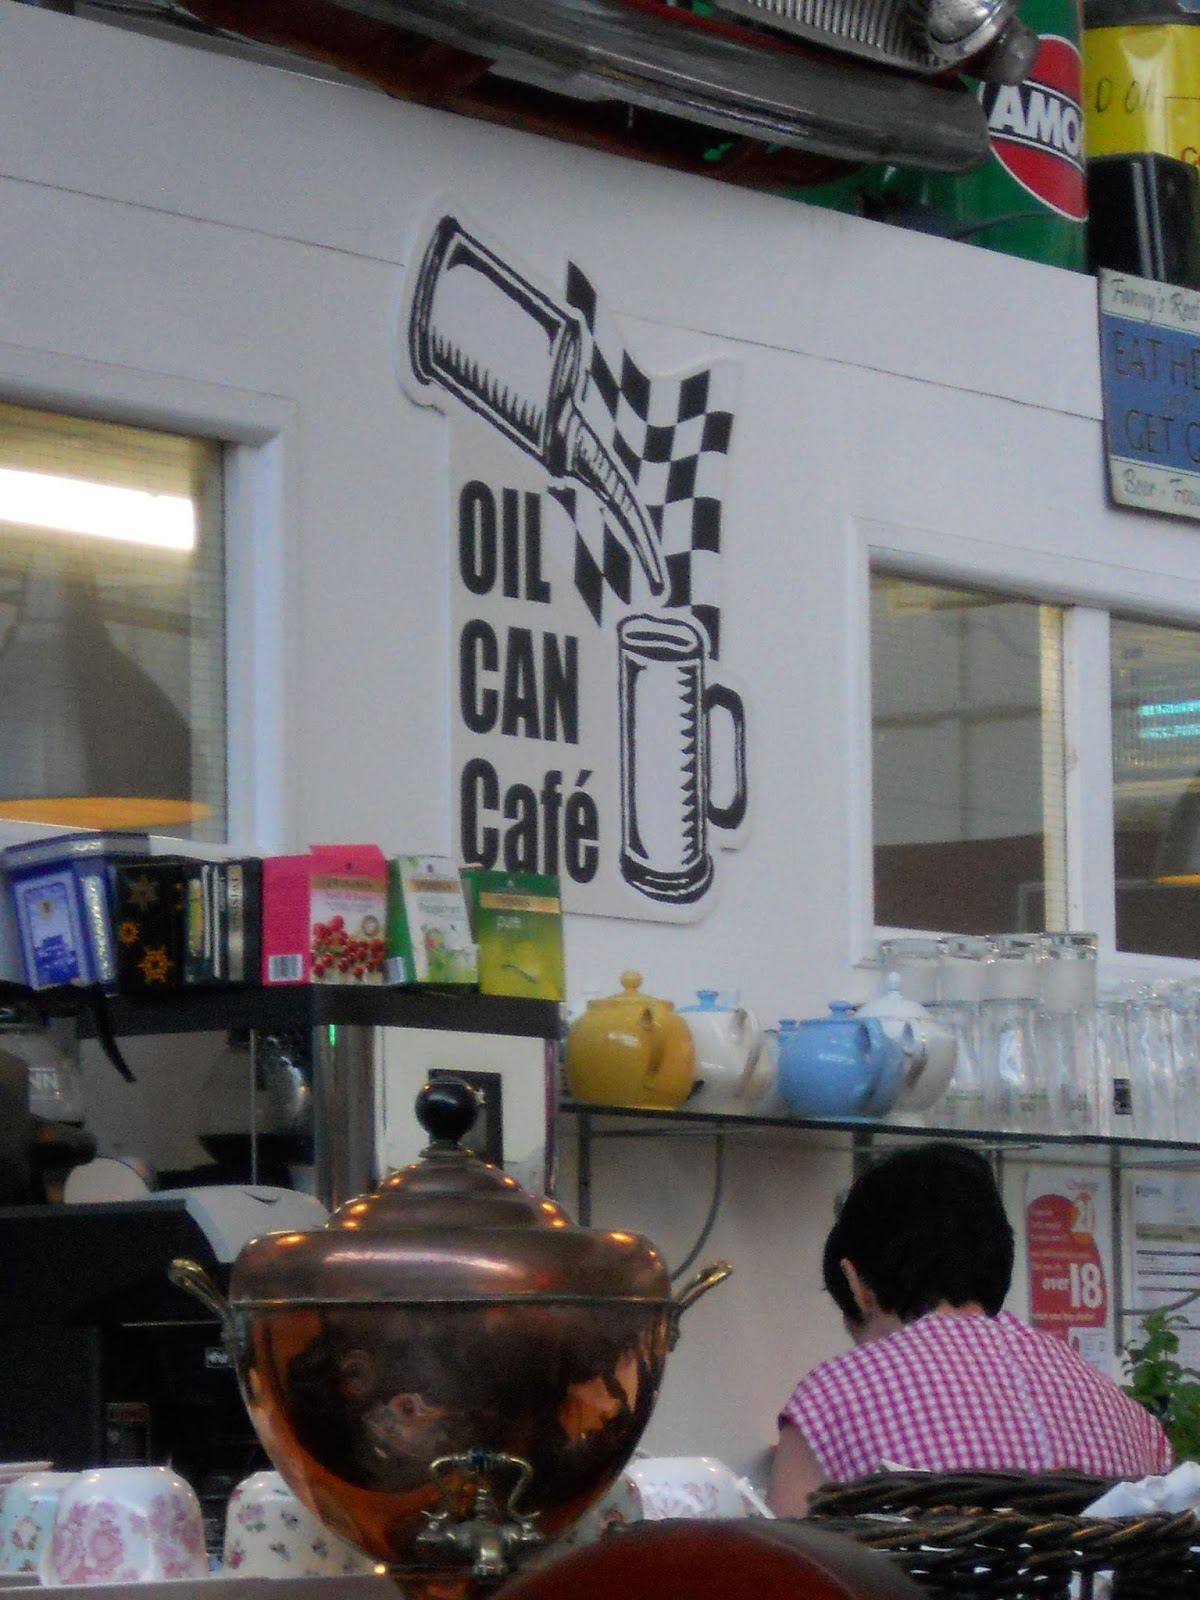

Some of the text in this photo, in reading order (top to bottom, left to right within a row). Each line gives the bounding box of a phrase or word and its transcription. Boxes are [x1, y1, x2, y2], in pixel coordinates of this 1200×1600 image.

[1112, 329, 1162, 380] EAT
[1124, 408, 1174, 453] GET
[459, 480, 551, 603] OIL
[460, 618, 579, 744] CAN
[461, 757, 599, 883] Café
[1070, 1263, 1103, 1308] 18
